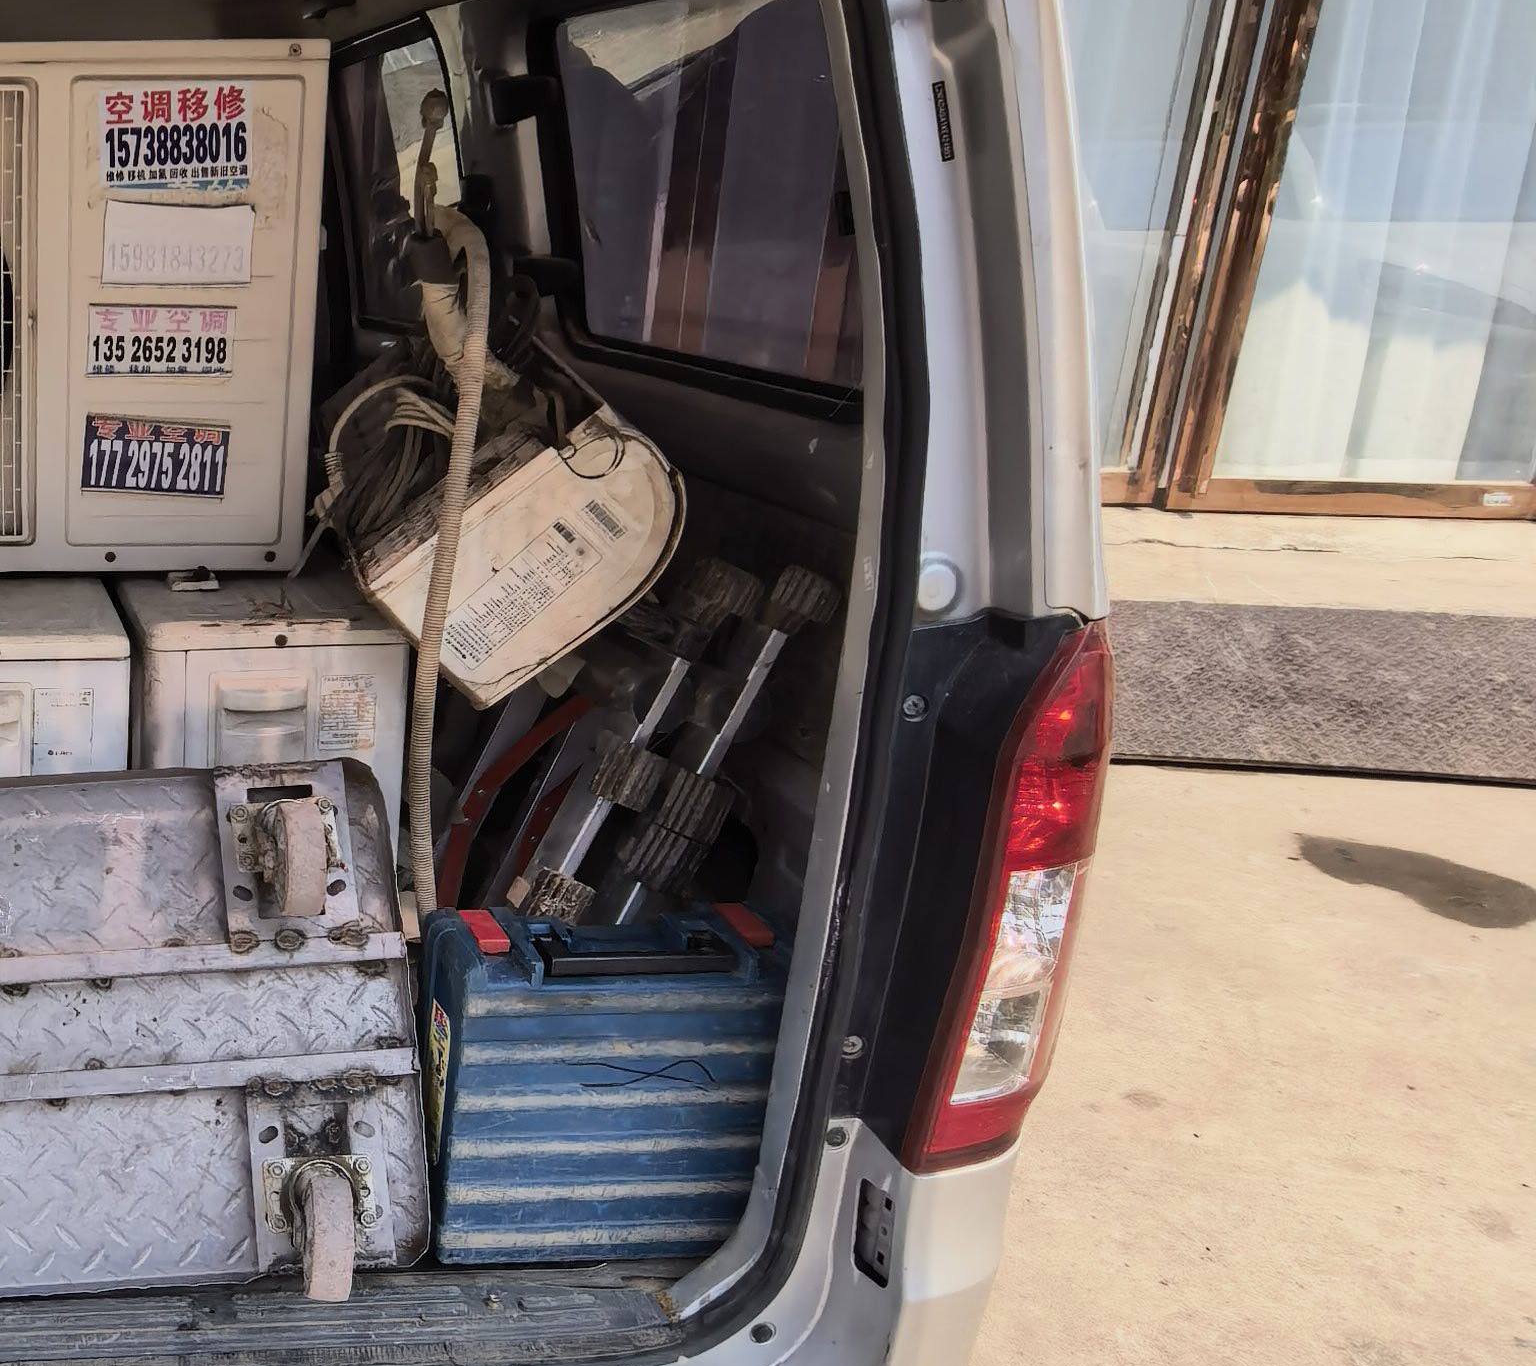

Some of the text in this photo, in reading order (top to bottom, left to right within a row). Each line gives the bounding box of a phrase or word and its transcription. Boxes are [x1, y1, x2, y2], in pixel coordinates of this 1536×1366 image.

[105, 85, 246, 124] 空调移修
[105, 121, 247, 168] 15738838016
[95, 308, 228, 334] 专业空调
[93, 335, 227, 364] 135 2652 3198
[92, 416, 222, 445] 专业空调
[89, 438, 225, 492] 177 2975 2811
